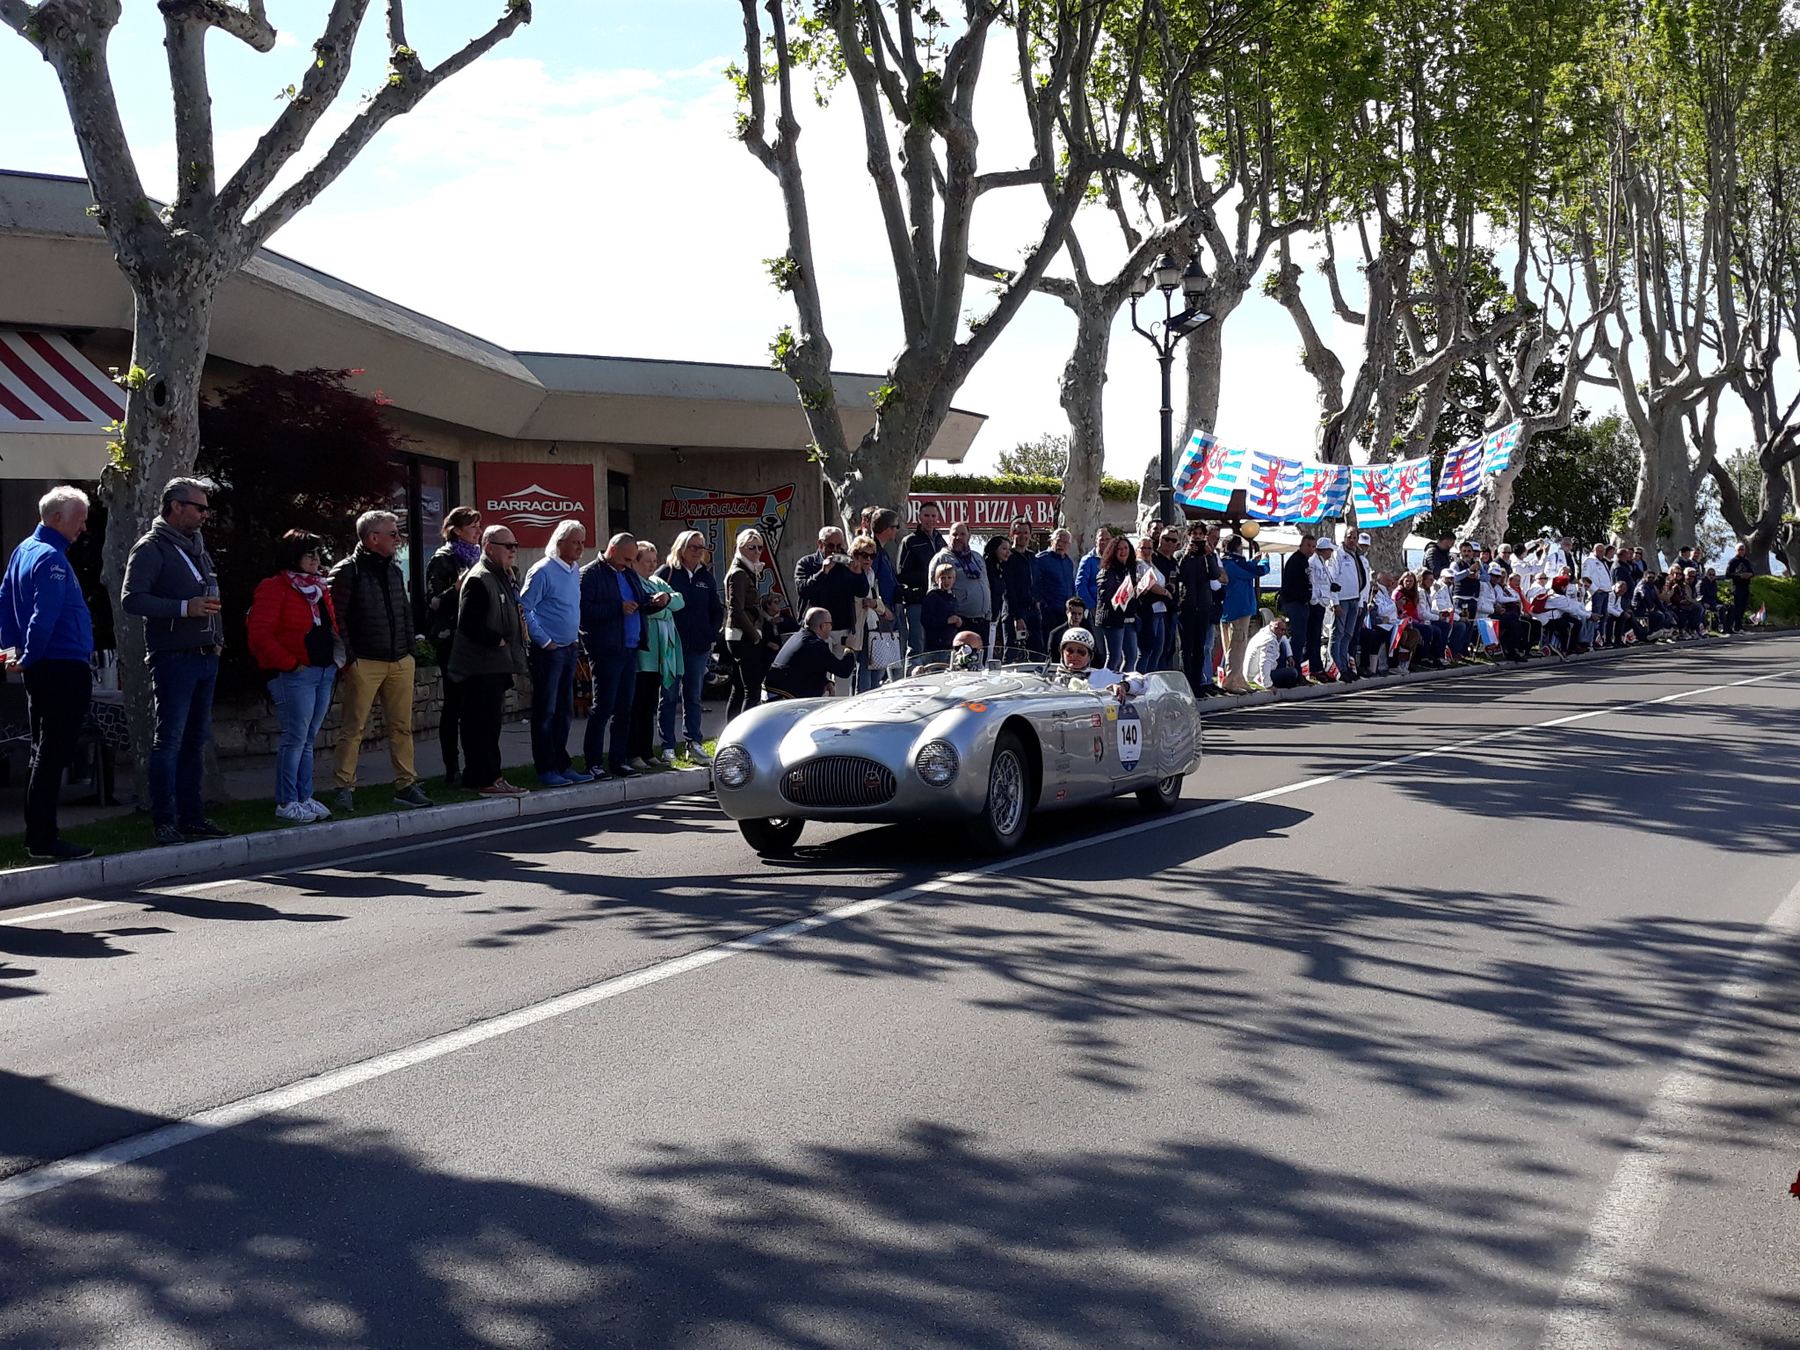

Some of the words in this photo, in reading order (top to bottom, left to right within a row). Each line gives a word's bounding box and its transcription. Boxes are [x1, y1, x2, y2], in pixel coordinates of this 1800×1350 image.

[487, 500, 585, 512] BARRACUDA
[678, 499, 758, 517] Barracuda
[907, 500, 970, 524] ORNTE
[974, 500, 1019, 524] PIZZA
[1024, 503, 1034, 524] &
[1121, 724, 1138, 746] 140
